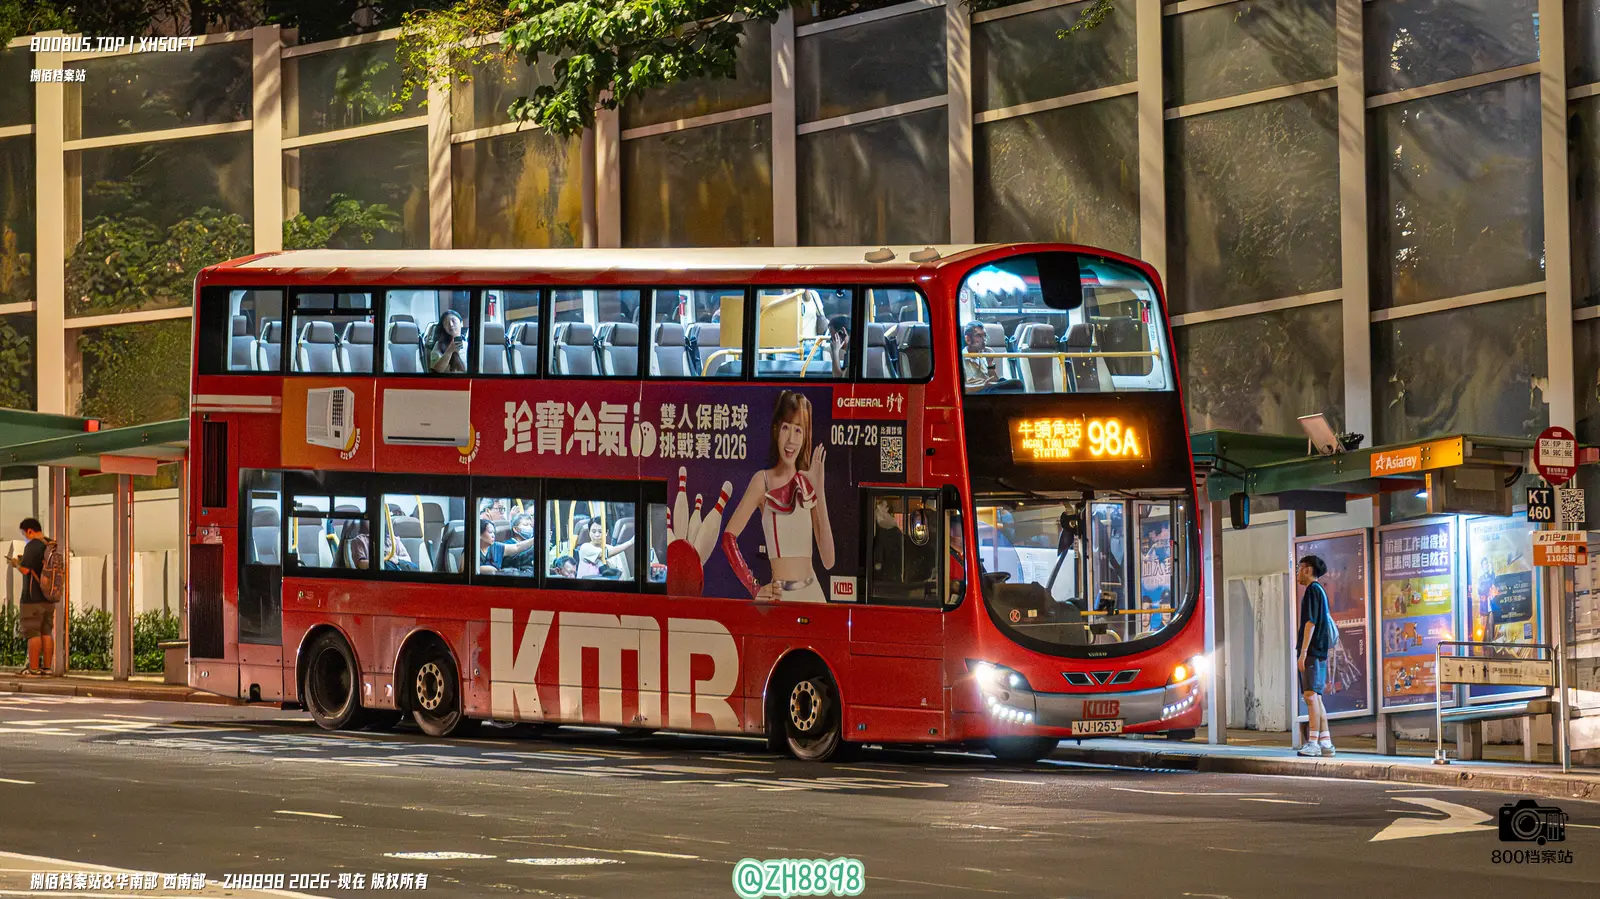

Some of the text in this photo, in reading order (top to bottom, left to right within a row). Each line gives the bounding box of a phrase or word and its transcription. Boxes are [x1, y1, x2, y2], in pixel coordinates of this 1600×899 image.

[659, 403, 748, 430] 雙人保齡球
[503, 399, 628, 457] 珍寶冷氣
[831, 424, 878, 446] 06.27-28
[1018, 420, 1082, 439] 牛頭角站
[1087, 420, 1139, 456] 98A
[1033, 448, 1071, 458] STATION
[1385, 455, 1418, 470] Asiaray
[1528, 490, 1550, 504] KT
[1528, 506, 1551, 520] 460
[833, 581, 854, 596] KMB
[490, 607, 740, 733] KMB
[1082, 700, 1121, 719] KMB
